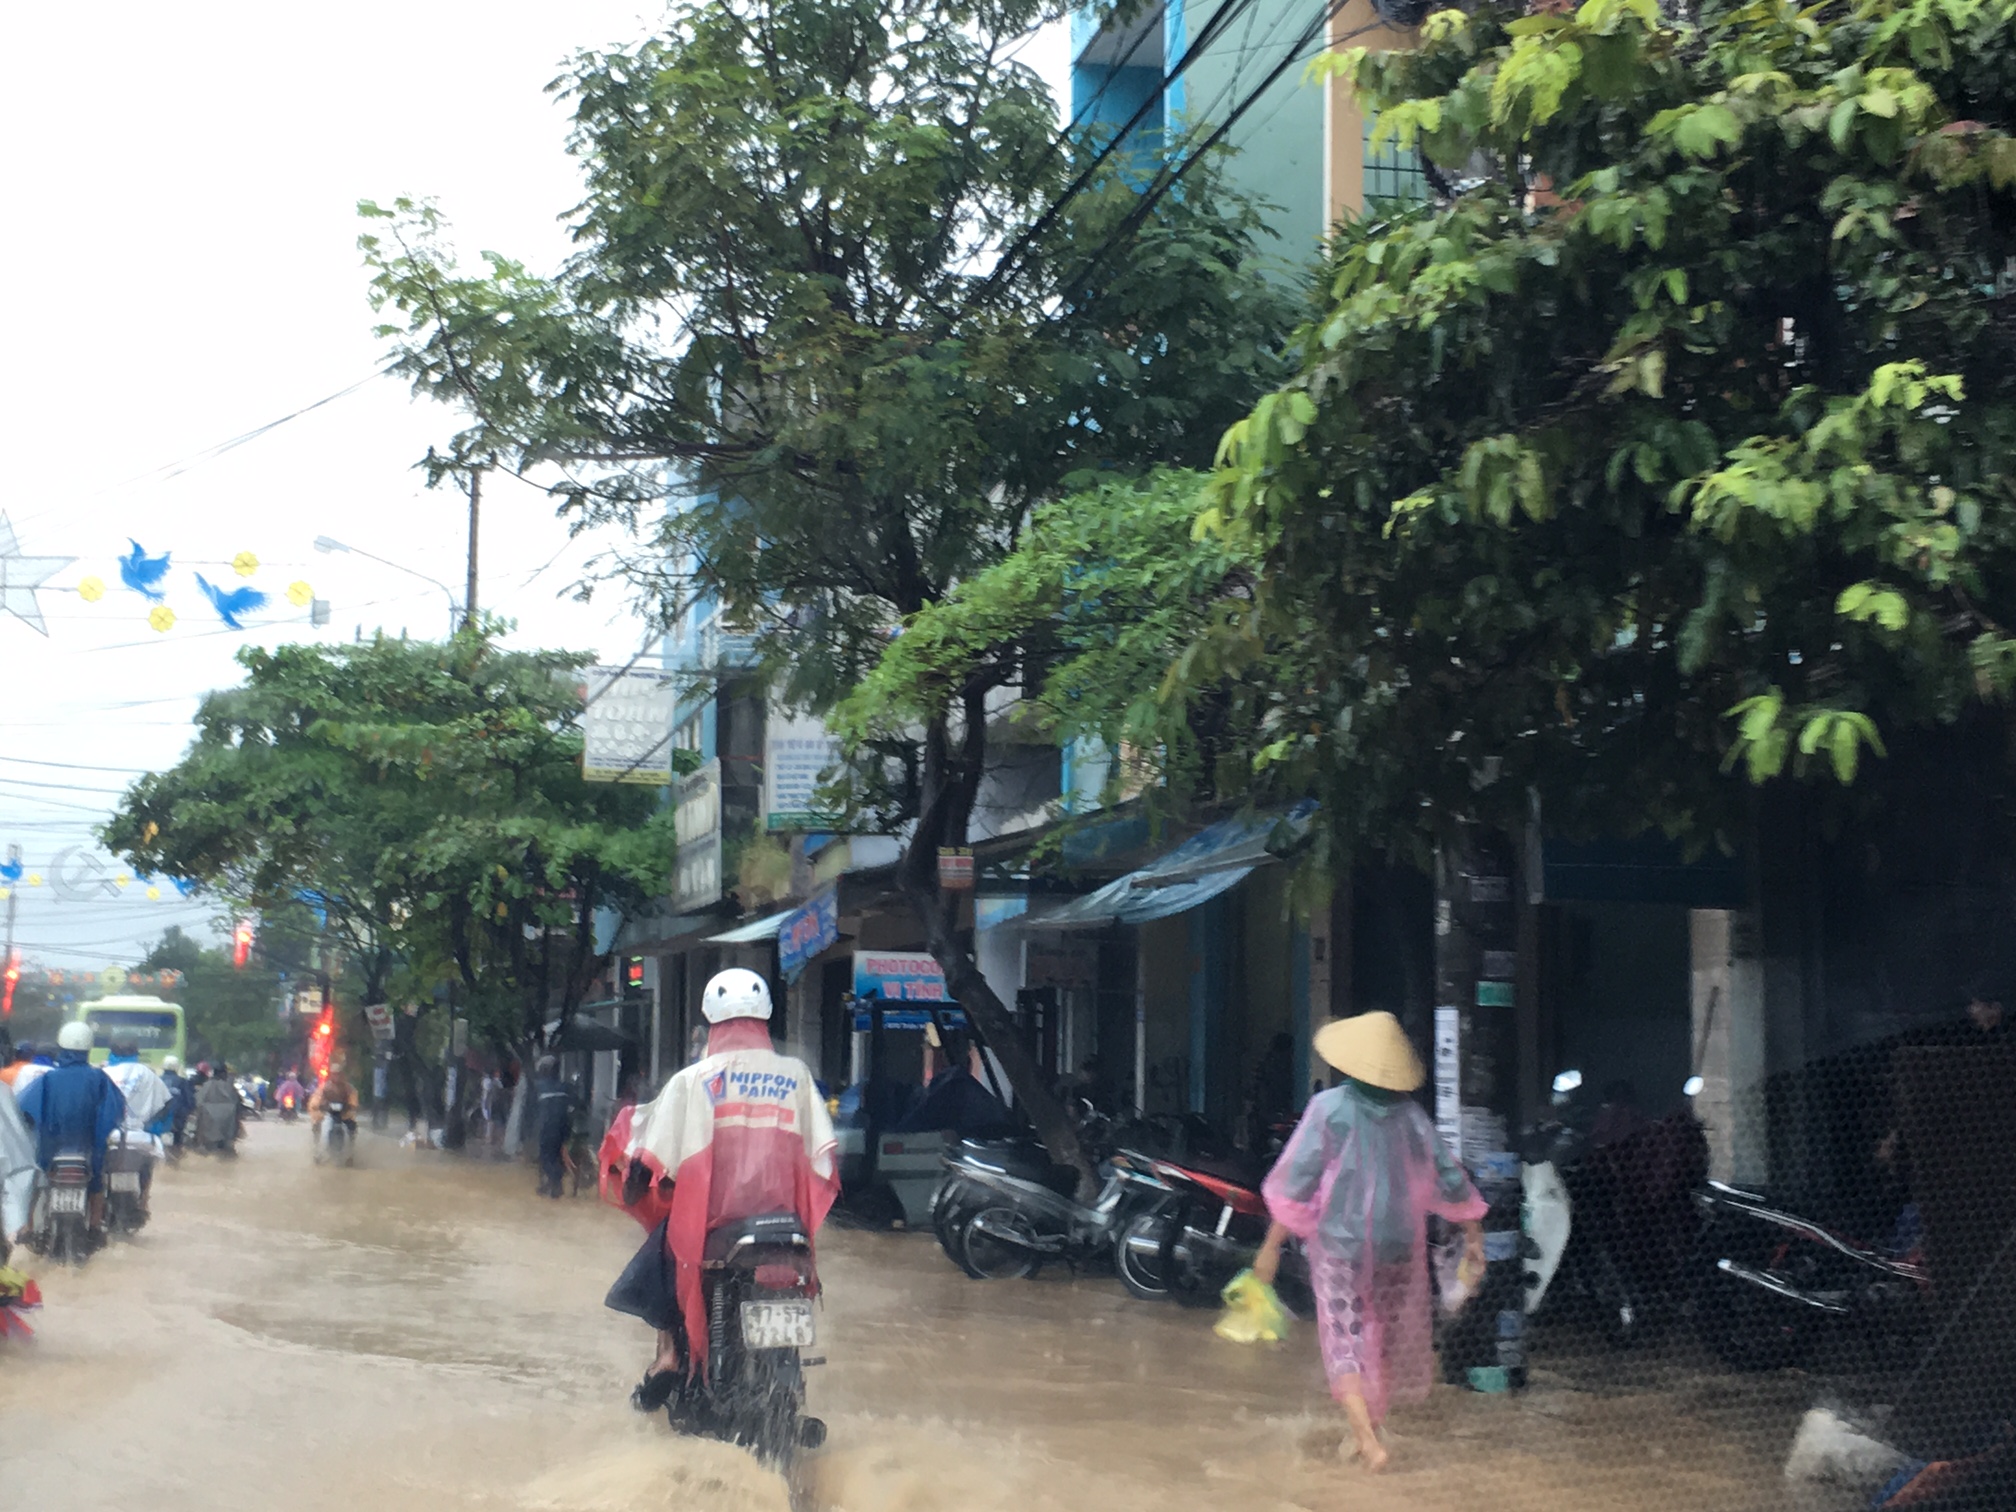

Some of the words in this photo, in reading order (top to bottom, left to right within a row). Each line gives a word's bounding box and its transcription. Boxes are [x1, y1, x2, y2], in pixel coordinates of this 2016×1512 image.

[866, 958, 945, 976] PHOTOCO
[882, 981, 901, 999] VI
[904, 978, 943, 1000] TÍNH
[730, 1071, 798, 1090] NIPPON
[739, 1084, 791, 1100] PAINT
